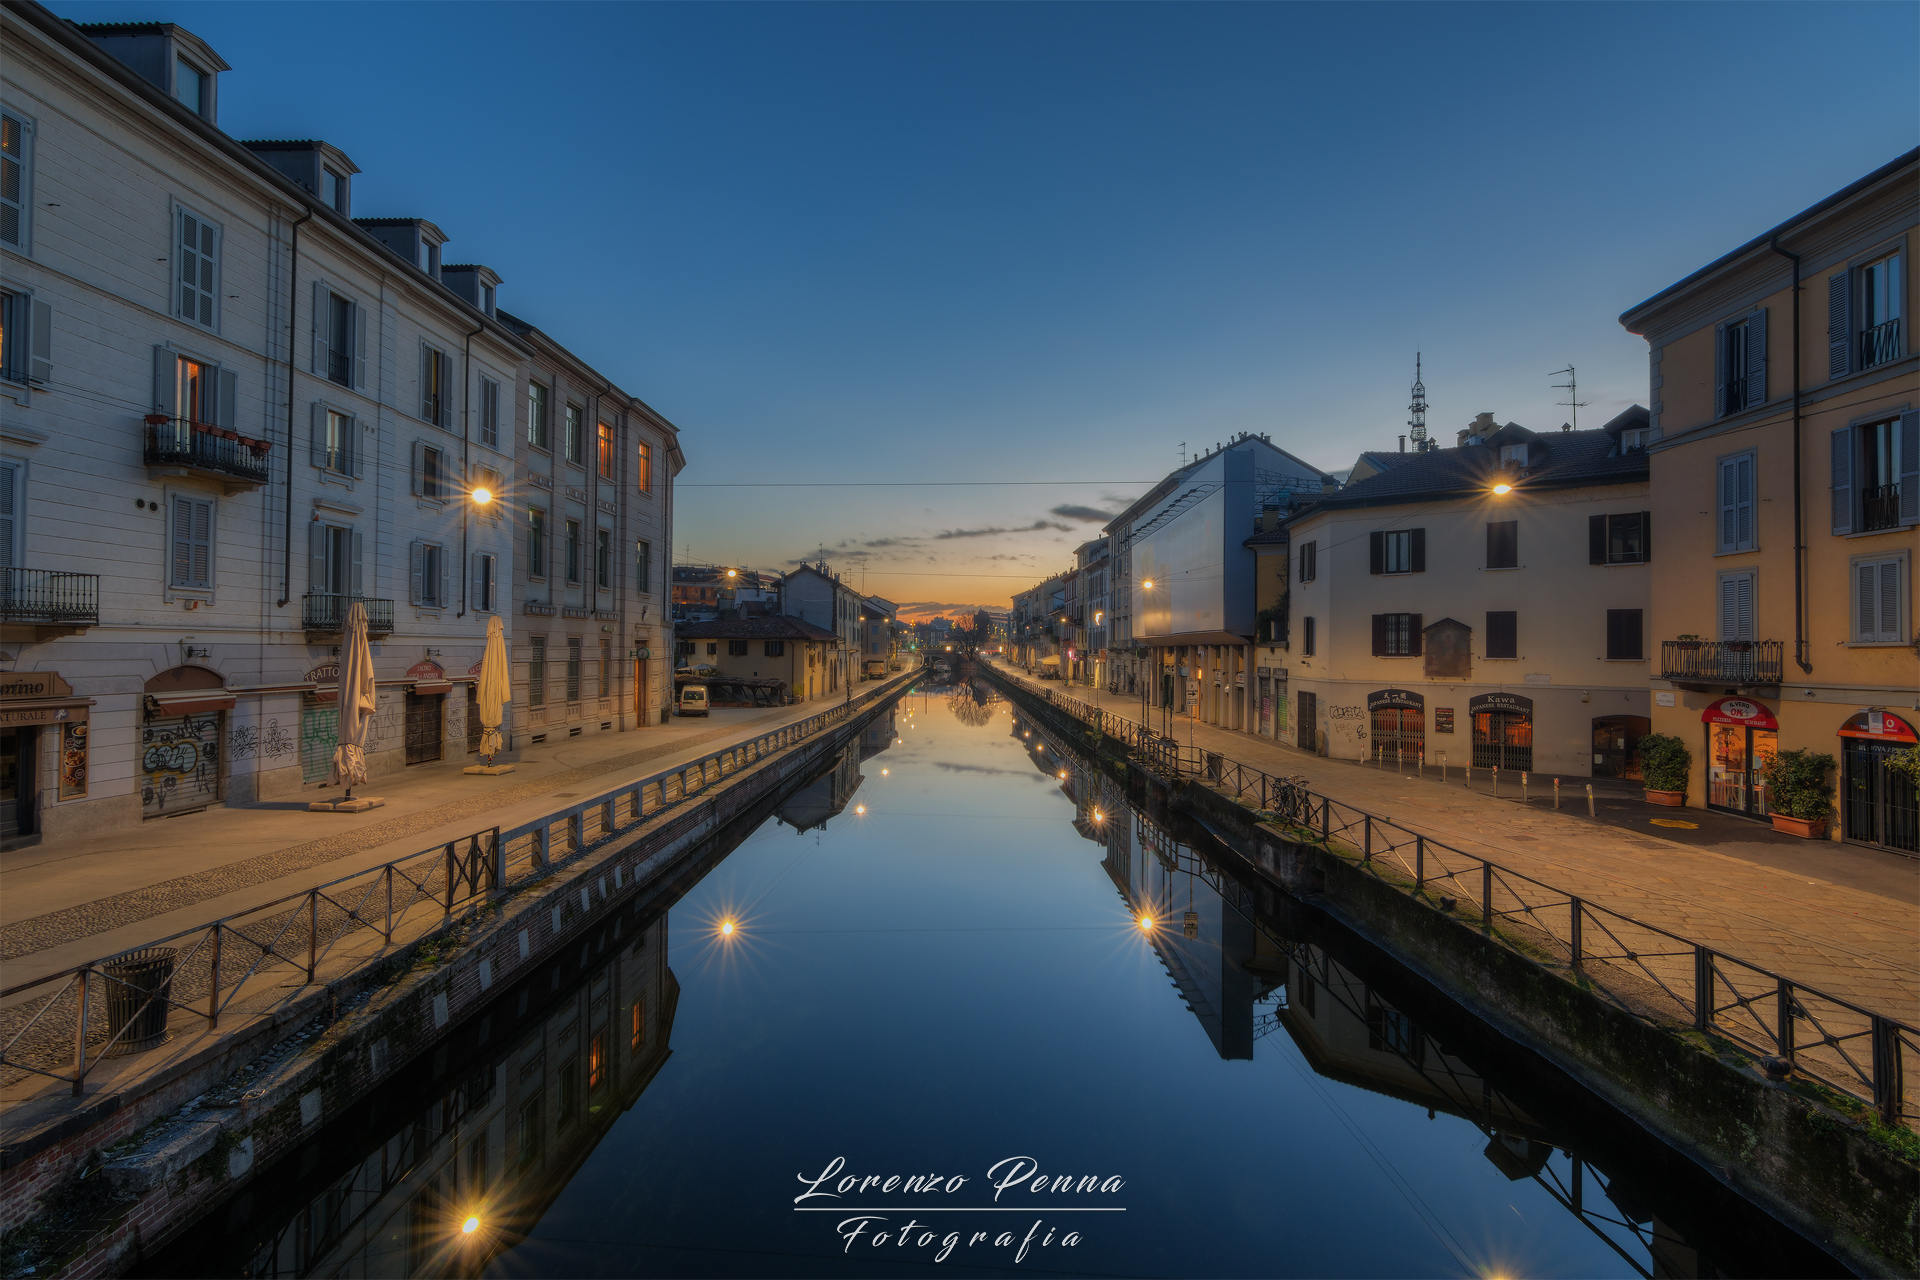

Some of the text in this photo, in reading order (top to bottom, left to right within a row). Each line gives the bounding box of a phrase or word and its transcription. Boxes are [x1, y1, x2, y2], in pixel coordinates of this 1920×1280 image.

[1487, 695, 1515, 703] Kawa
[1370, 699, 1422, 708] JAPANESE RESTAURANT
[1734, 701, 1750, 709] VERO
[1471, 703, 1530, 714] JAPANESE RESTAURANT
